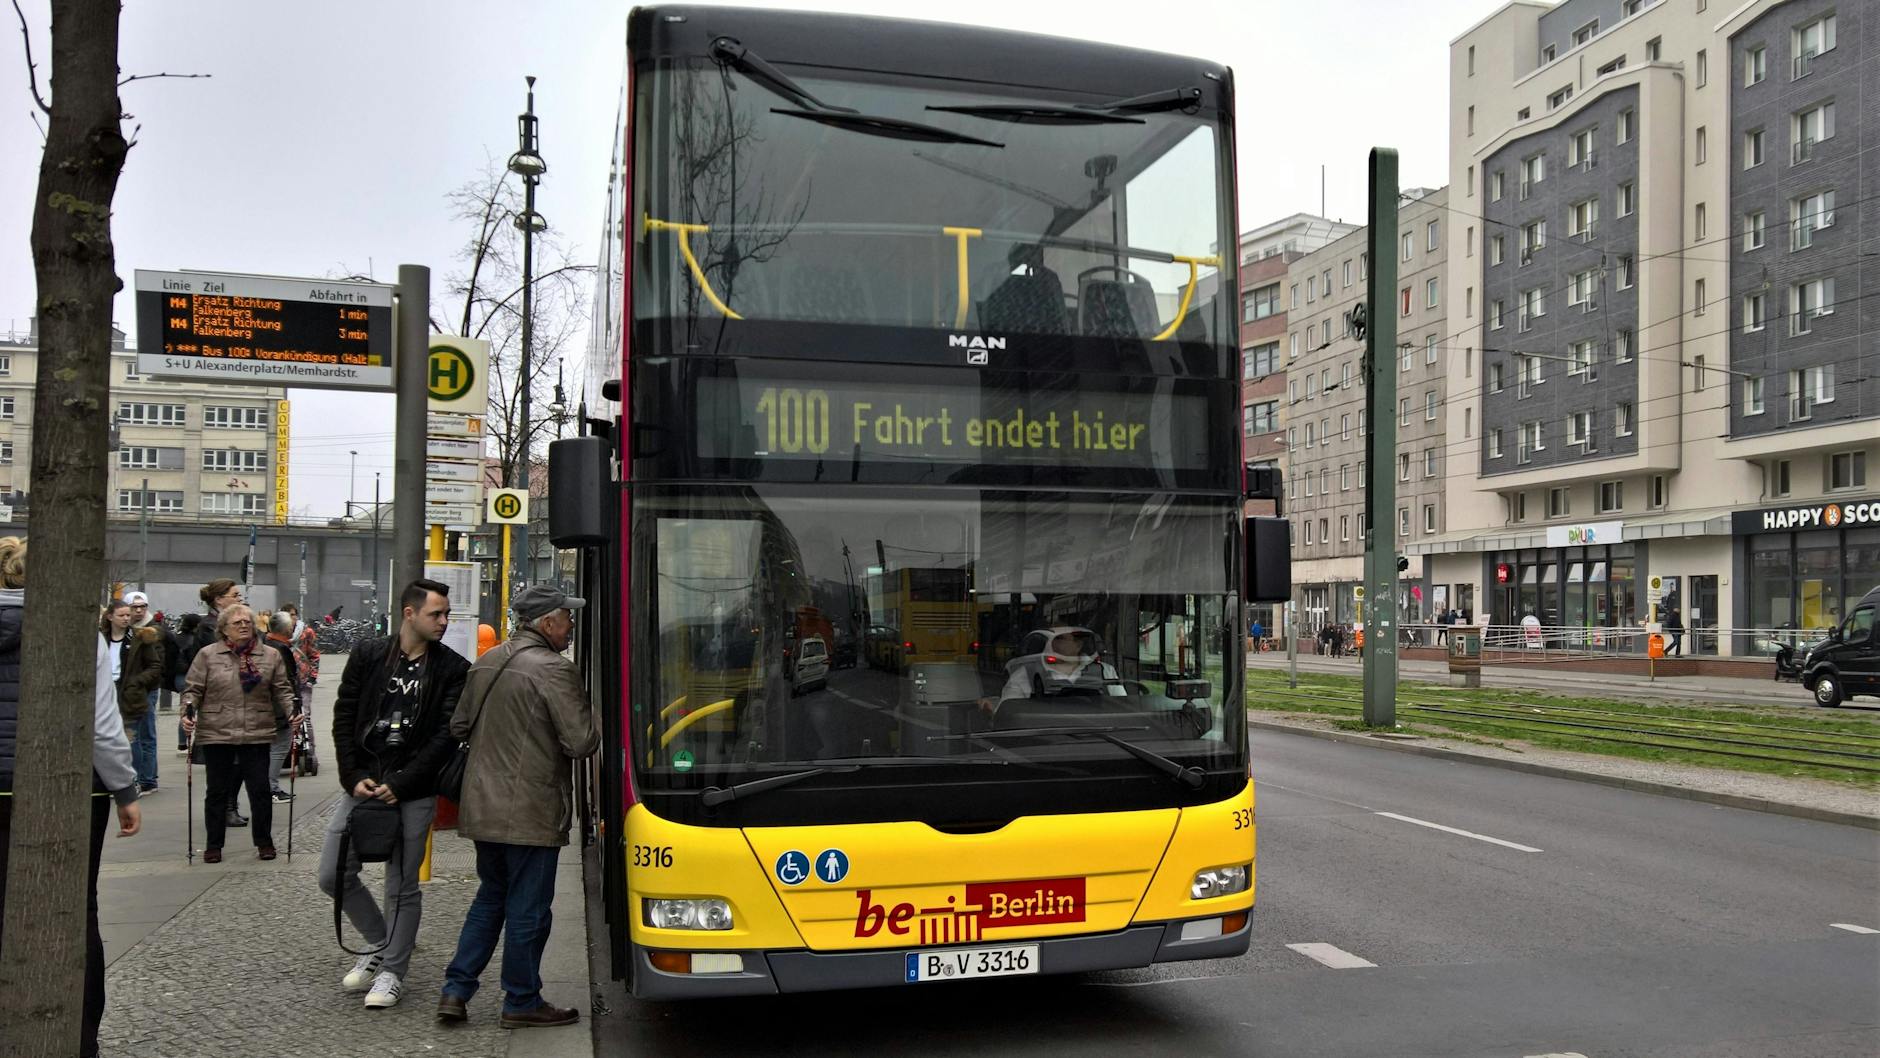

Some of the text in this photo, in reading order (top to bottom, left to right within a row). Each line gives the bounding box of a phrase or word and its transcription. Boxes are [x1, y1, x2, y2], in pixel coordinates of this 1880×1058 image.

[162, 279, 225, 293] Linie Ziel
[170, 294, 281, 310] M4 Ersatz Richtung
[309, 289, 367, 303] Abfahrt in
[193, 305, 252, 317] Falkenberg
[339, 308, 367, 320] 1 min
[170, 315, 281, 331] M4 Ersatz Richtung
[193, 325, 252, 339] Falkenberg
[339, 328, 367, 340] 3 min
[949, 335, 1006, 349] MAN
[202, 345, 222, 356] Bus
[255, 348, 337, 363] Vorankündigung
[165, 358, 358, 378] S+U Alexanderplatz/Memhardstr.
[430, 358, 459, 388] H
[755, 387, 830, 455] 100
[854, 402, 1144, 450] Fahrt endet hier
[1763, 507, 1823, 529] HAPPY
[633, 844, 673, 868] 3316
[854, 889, 1075, 938] be Berlin
